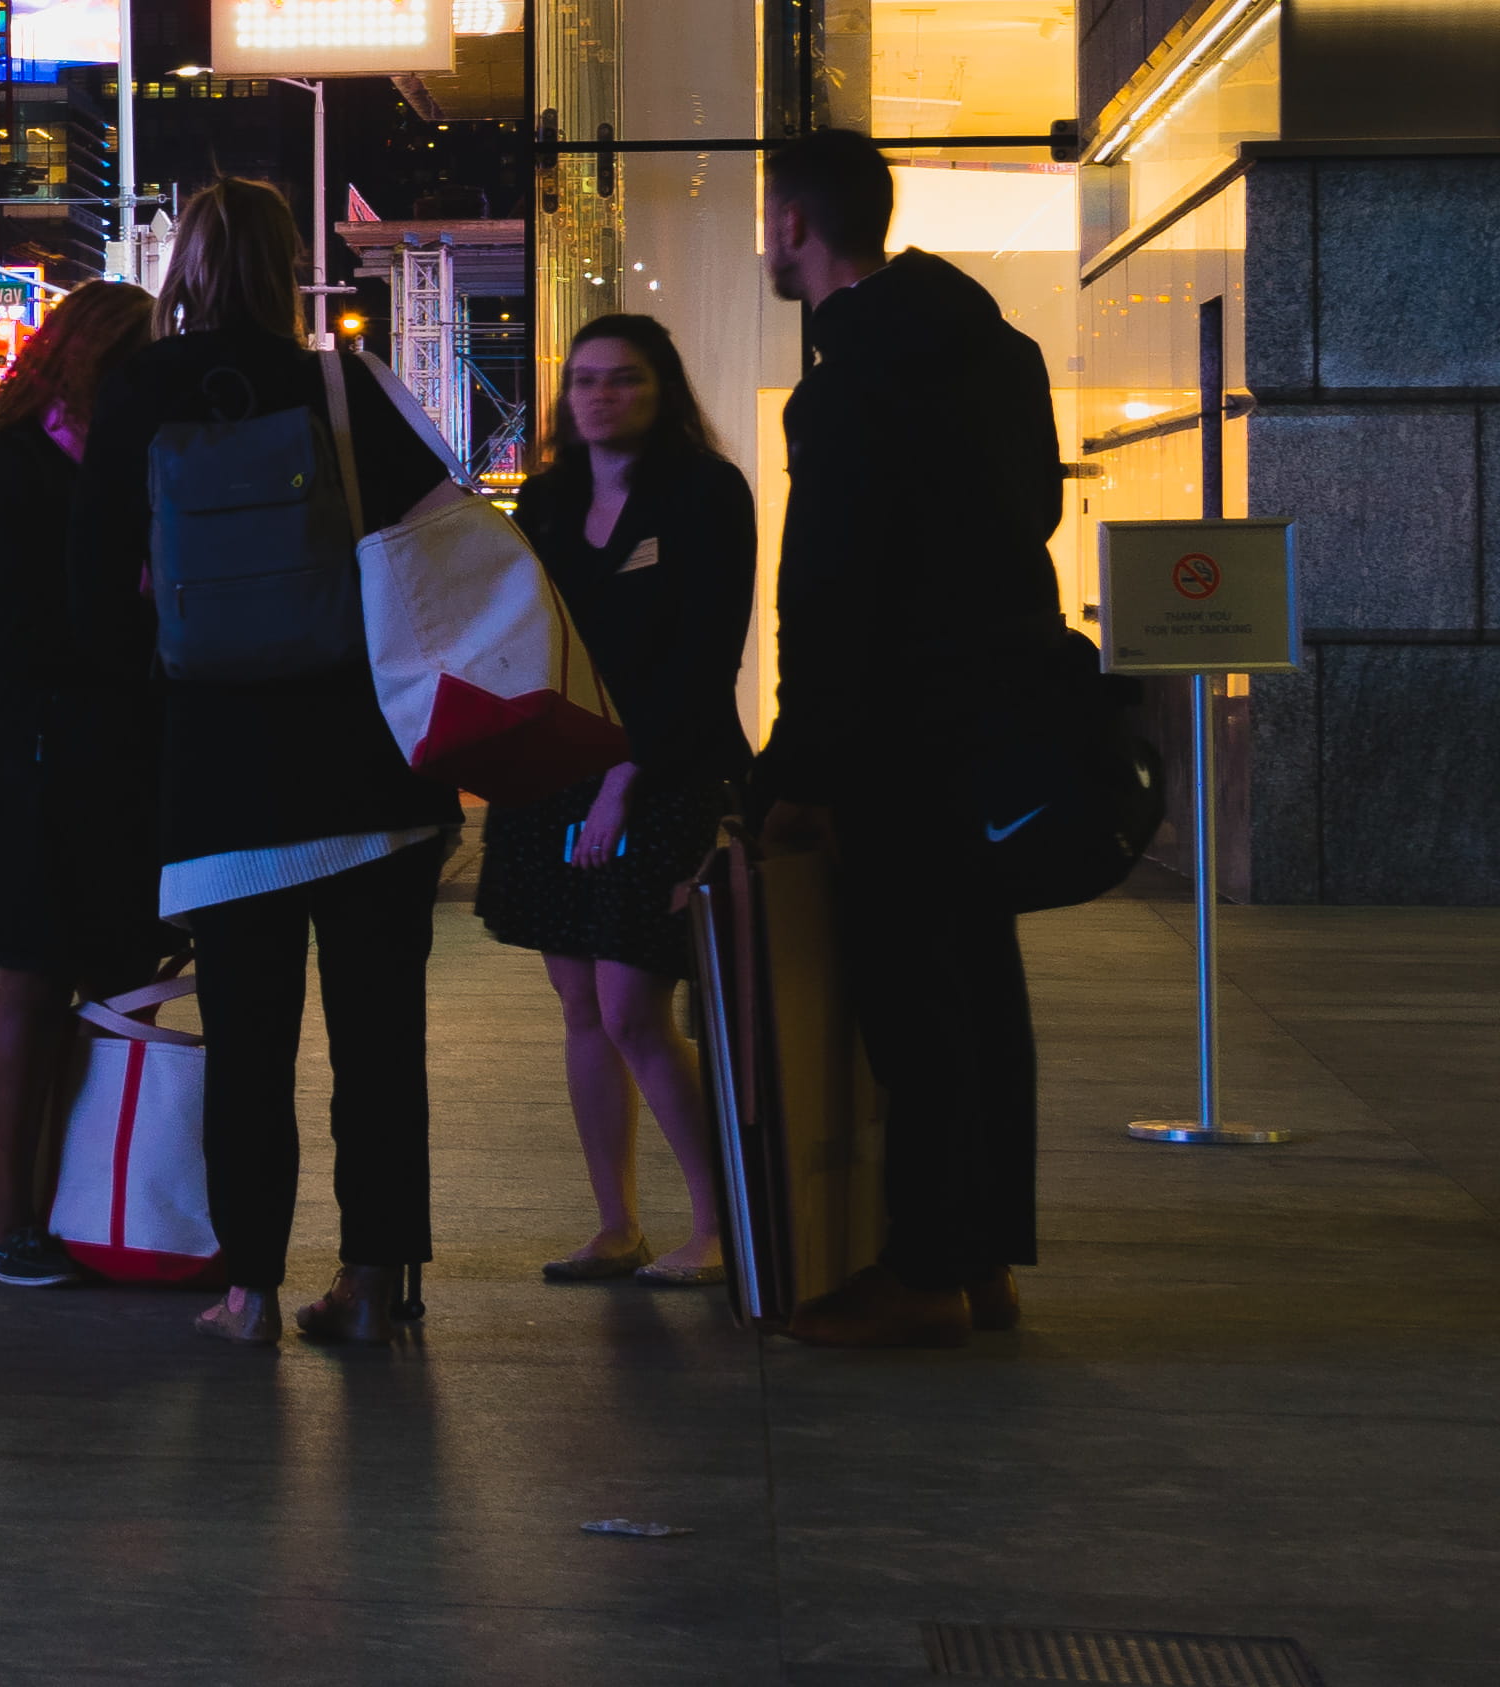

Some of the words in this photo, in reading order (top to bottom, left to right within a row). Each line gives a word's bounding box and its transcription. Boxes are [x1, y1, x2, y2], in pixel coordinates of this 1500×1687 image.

[1165, 611, 1201, 622] THANK
[1208, 611, 1232, 622] YOU
[1145, 624, 1168, 636] FOR
[1171, 624, 1195, 635] NOT
[1199, 623, 1253, 635] SMOKING
